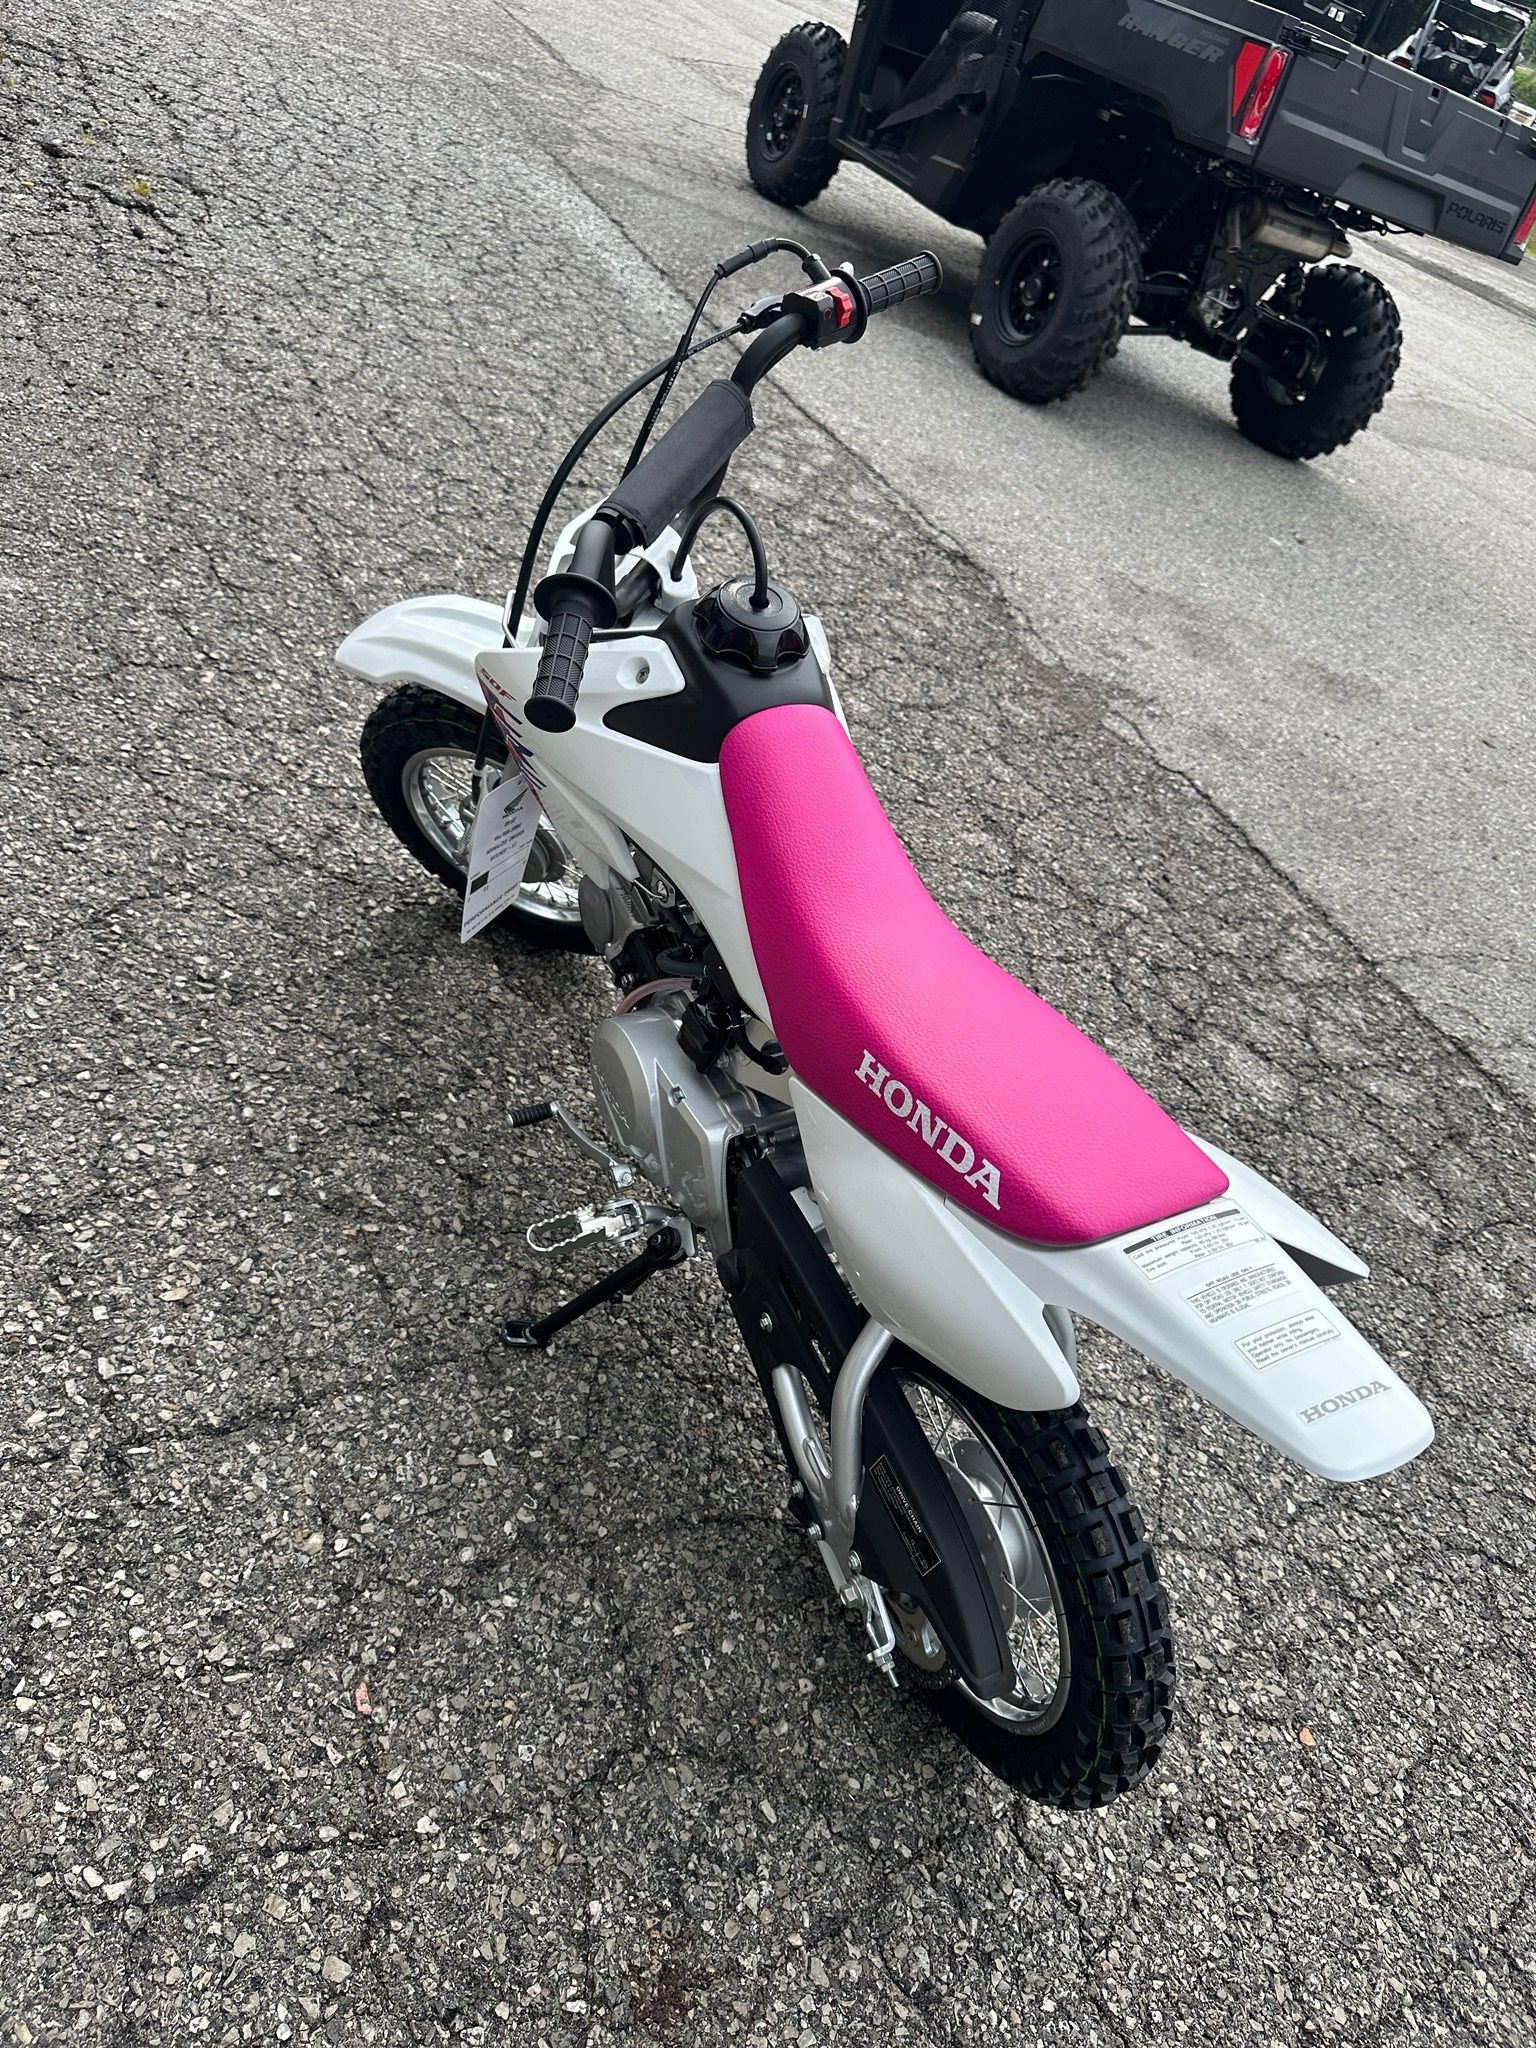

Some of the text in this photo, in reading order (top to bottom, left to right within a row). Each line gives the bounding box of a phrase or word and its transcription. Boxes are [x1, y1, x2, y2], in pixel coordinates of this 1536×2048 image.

[1117, 12, 1225, 63] RANGER
[1446, 202, 1506, 234] POLARIS
[464, 894, 503, 928] PERFORMANCE
[854, 1049, 1001, 1211] HONDA
[1150, 1214, 1218, 1242] TIRE INFORMATION
[1164, 1250, 1178, 1258] weight
[1288, 1320, 1304, 1328] always
[1252, 1347, 1272, 1358] Operator
[1256, 1355, 1270, 1364] Read
[1300, 1380, 1392, 1424] HONDA
[896, 1486, 910, 1509] DRIVE
[908, 1509, 922, 1534] CHAIN
